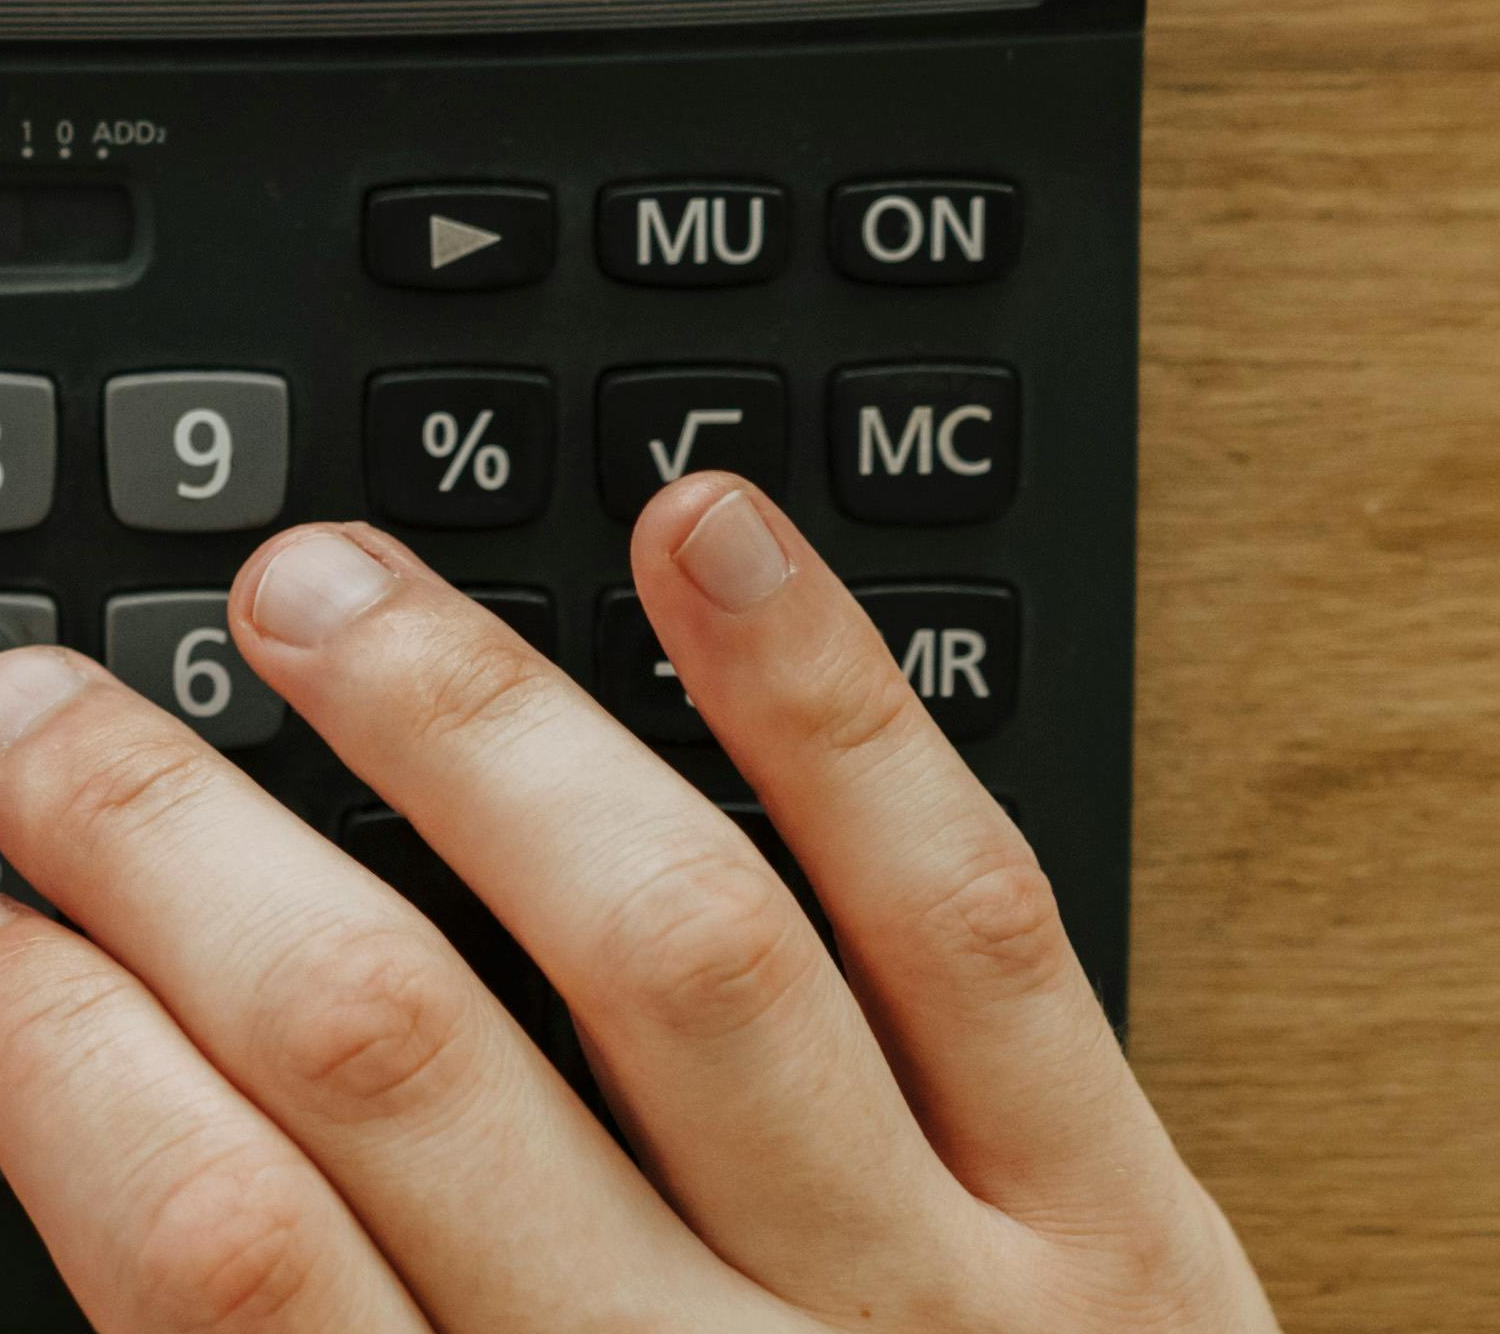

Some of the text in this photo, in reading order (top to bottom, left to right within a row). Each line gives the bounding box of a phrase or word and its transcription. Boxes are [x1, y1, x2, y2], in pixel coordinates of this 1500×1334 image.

[21, 120, 32, 143] 1
[638, 197, 764, 265] MU
[862, 195, 985, 262] ON
[173, 408, 232, 499] 9
[422, 410, 510, 492] %
[859, 404, 992, 476] MC
[171, 628, 231, 718] 6
